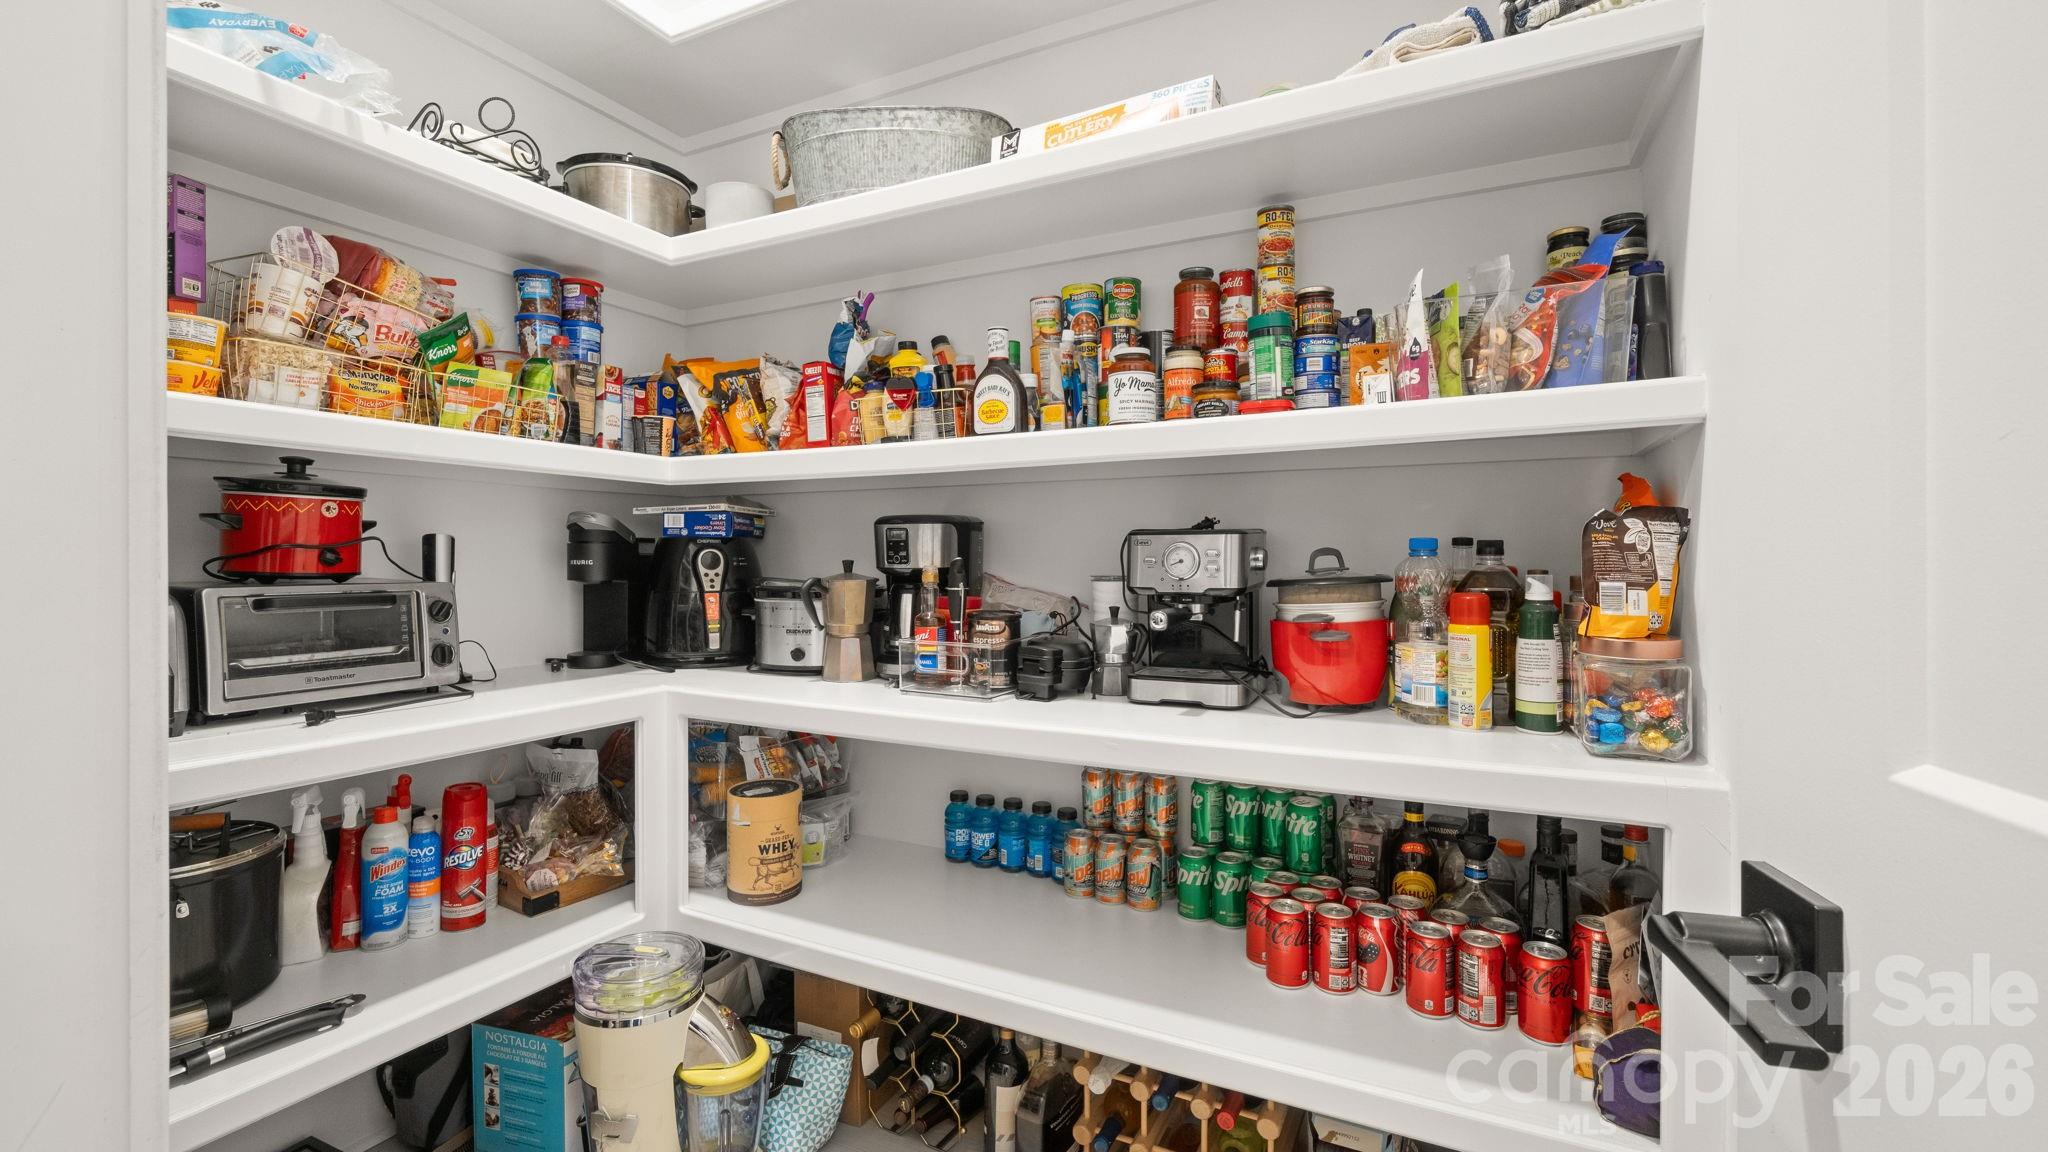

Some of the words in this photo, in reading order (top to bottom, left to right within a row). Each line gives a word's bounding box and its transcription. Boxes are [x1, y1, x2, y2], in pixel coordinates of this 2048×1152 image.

[209, 17, 276, 29] EVERYDAY
[1151, 89, 1170, 100] 360
[1047, 112, 1118, 147] CUTLERY
[426, 344, 458, 361] Knorr
[1114, 377, 1127, 397] Yo
[1167, 377, 1197, 387] Alfredo
[1591, 519, 1617, 529] Dove
[973, 637, 1006, 645] espresso
[314, 673, 356, 682] Toastmaster
[757, 839, 795, 856] WHEY
[444, 846, 484, 868] RESOLVE
[1347, 853, 1376, 863] WHITNEY
[370, 858, 407, 883] Windex
[375, 884, 403, 897] FOAM
[485, 1031, 548, 1053] NOSTALGIA
[486, 1050, 513, 1062] CHOCOLAT
